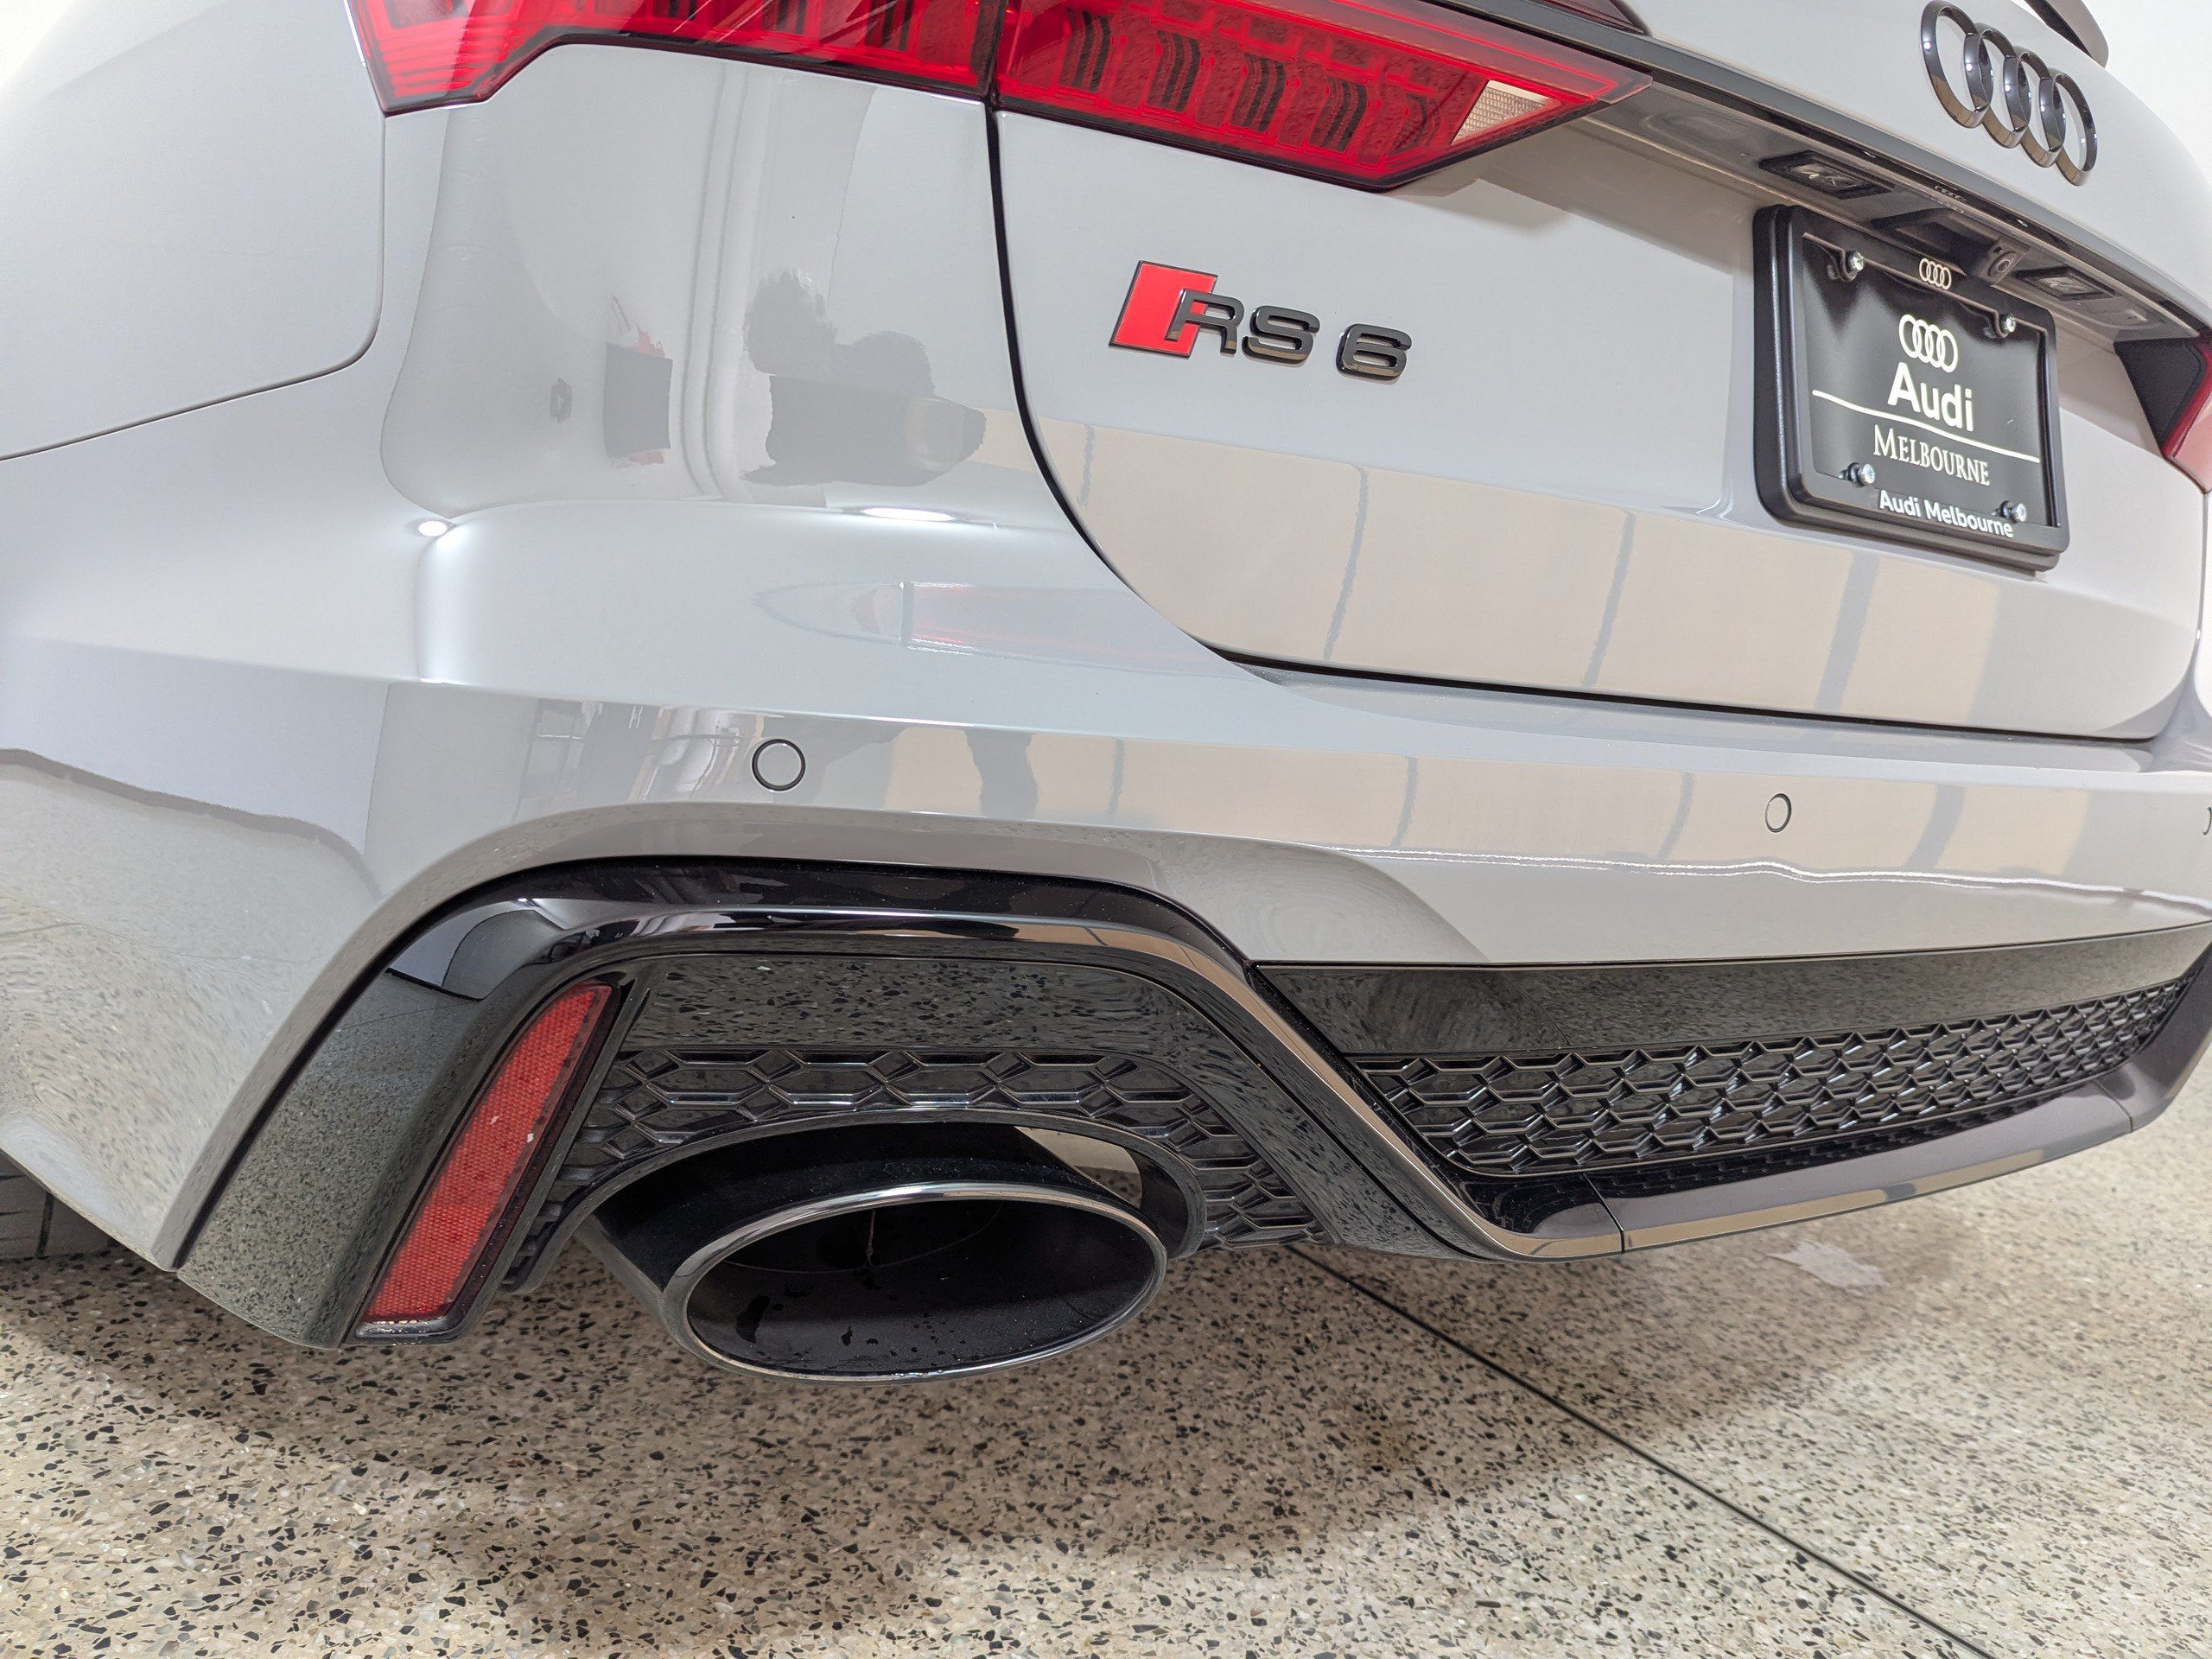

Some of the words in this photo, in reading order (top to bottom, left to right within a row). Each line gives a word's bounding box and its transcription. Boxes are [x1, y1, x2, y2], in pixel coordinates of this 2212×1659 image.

[1163, 288, 1321, 365] RS
[1335, 323, 1413, 381] 6
[1886, 361, 1974, 432] Audi
[1873, 424, 1991, 486] MELBOURNE
[1879, 489, 1922, 518] Audi
[1923, 499, 2014, 538] Melbourne
